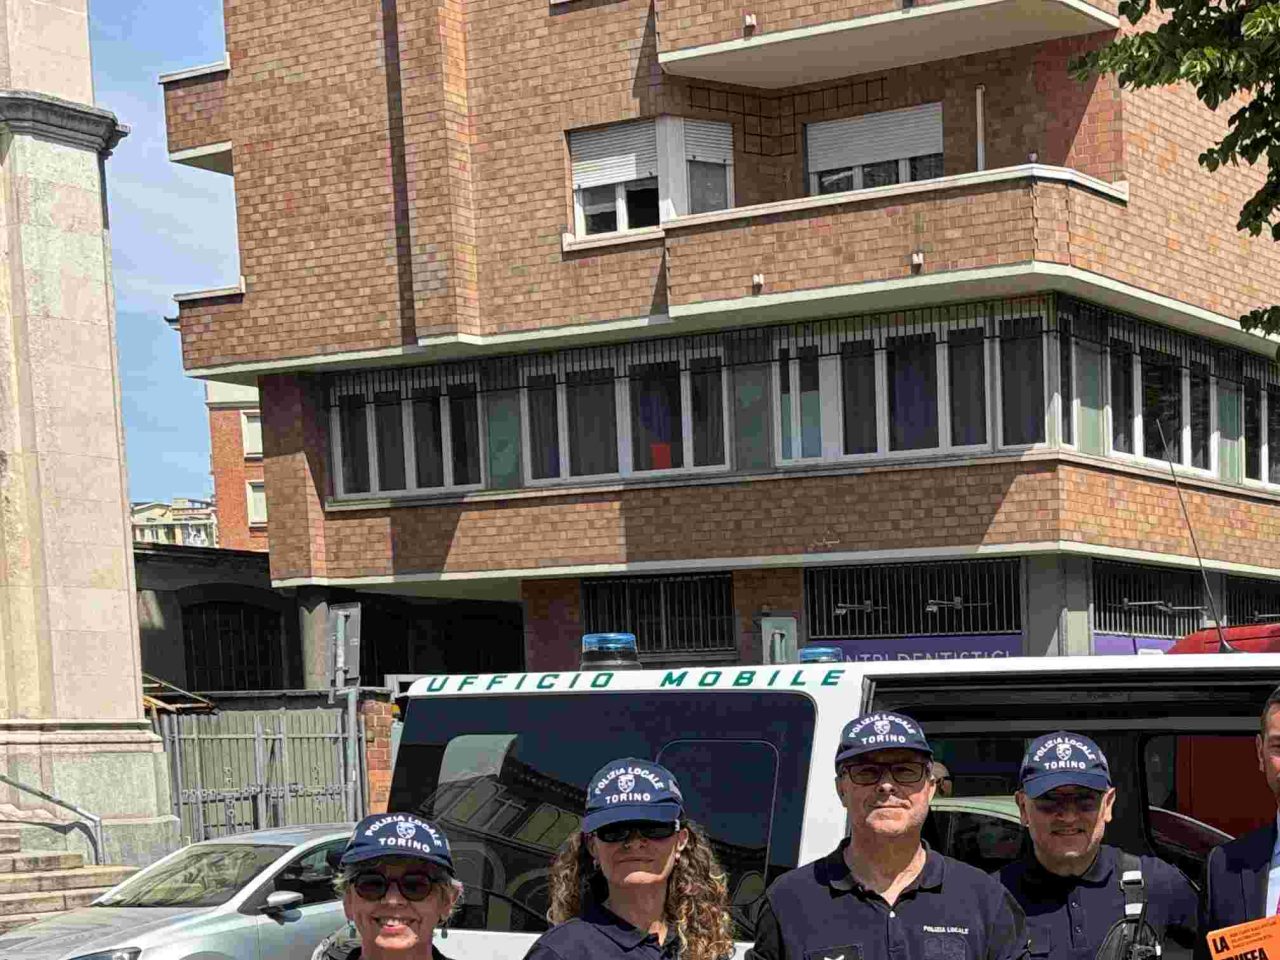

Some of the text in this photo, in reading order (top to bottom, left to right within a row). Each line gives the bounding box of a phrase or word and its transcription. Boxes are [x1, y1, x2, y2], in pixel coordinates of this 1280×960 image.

[426, 669, 847, 693] UFFICIO MOBILE
[849, 713, 918, 737] POLIZIA LOCALE
[861, 735, 906, 745] TORINO
[1033, 736, 1097, 761] POLIZIA LOCALE
[1044, 760, 1086, 770] TORINO
[595, 766, 665, 794] POLIZIA LOCALE
[605, 792, 651, 804] TORINO
[364, 814, 443, 848] POLIZIA LOCALE
[378, 836, 431, 853] TORINO
[1212, 936, 1230, 954] LA
